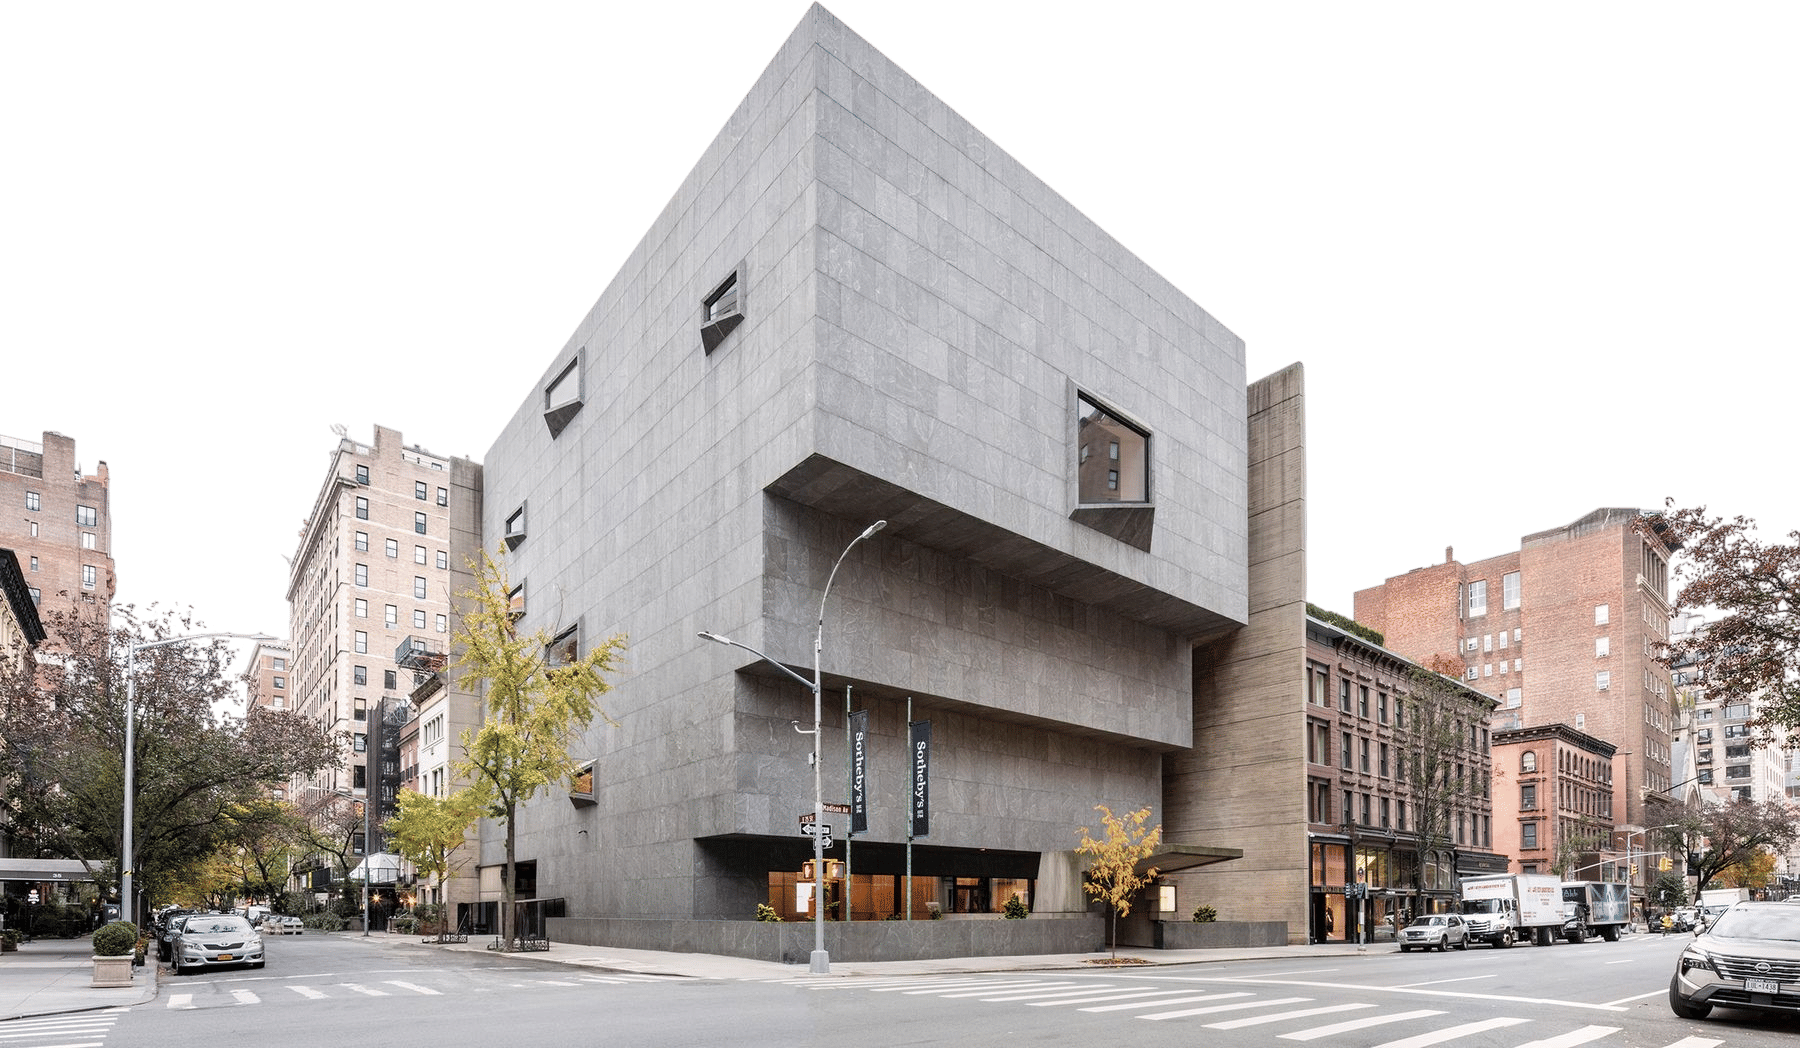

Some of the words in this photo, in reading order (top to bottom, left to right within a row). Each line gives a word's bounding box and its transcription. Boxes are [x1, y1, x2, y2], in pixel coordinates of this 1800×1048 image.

[854, 731, 864, 803] Sotheby's
[915, 741, 927, 808] Sotheby's
[822, 804, 842, 813] Madison
